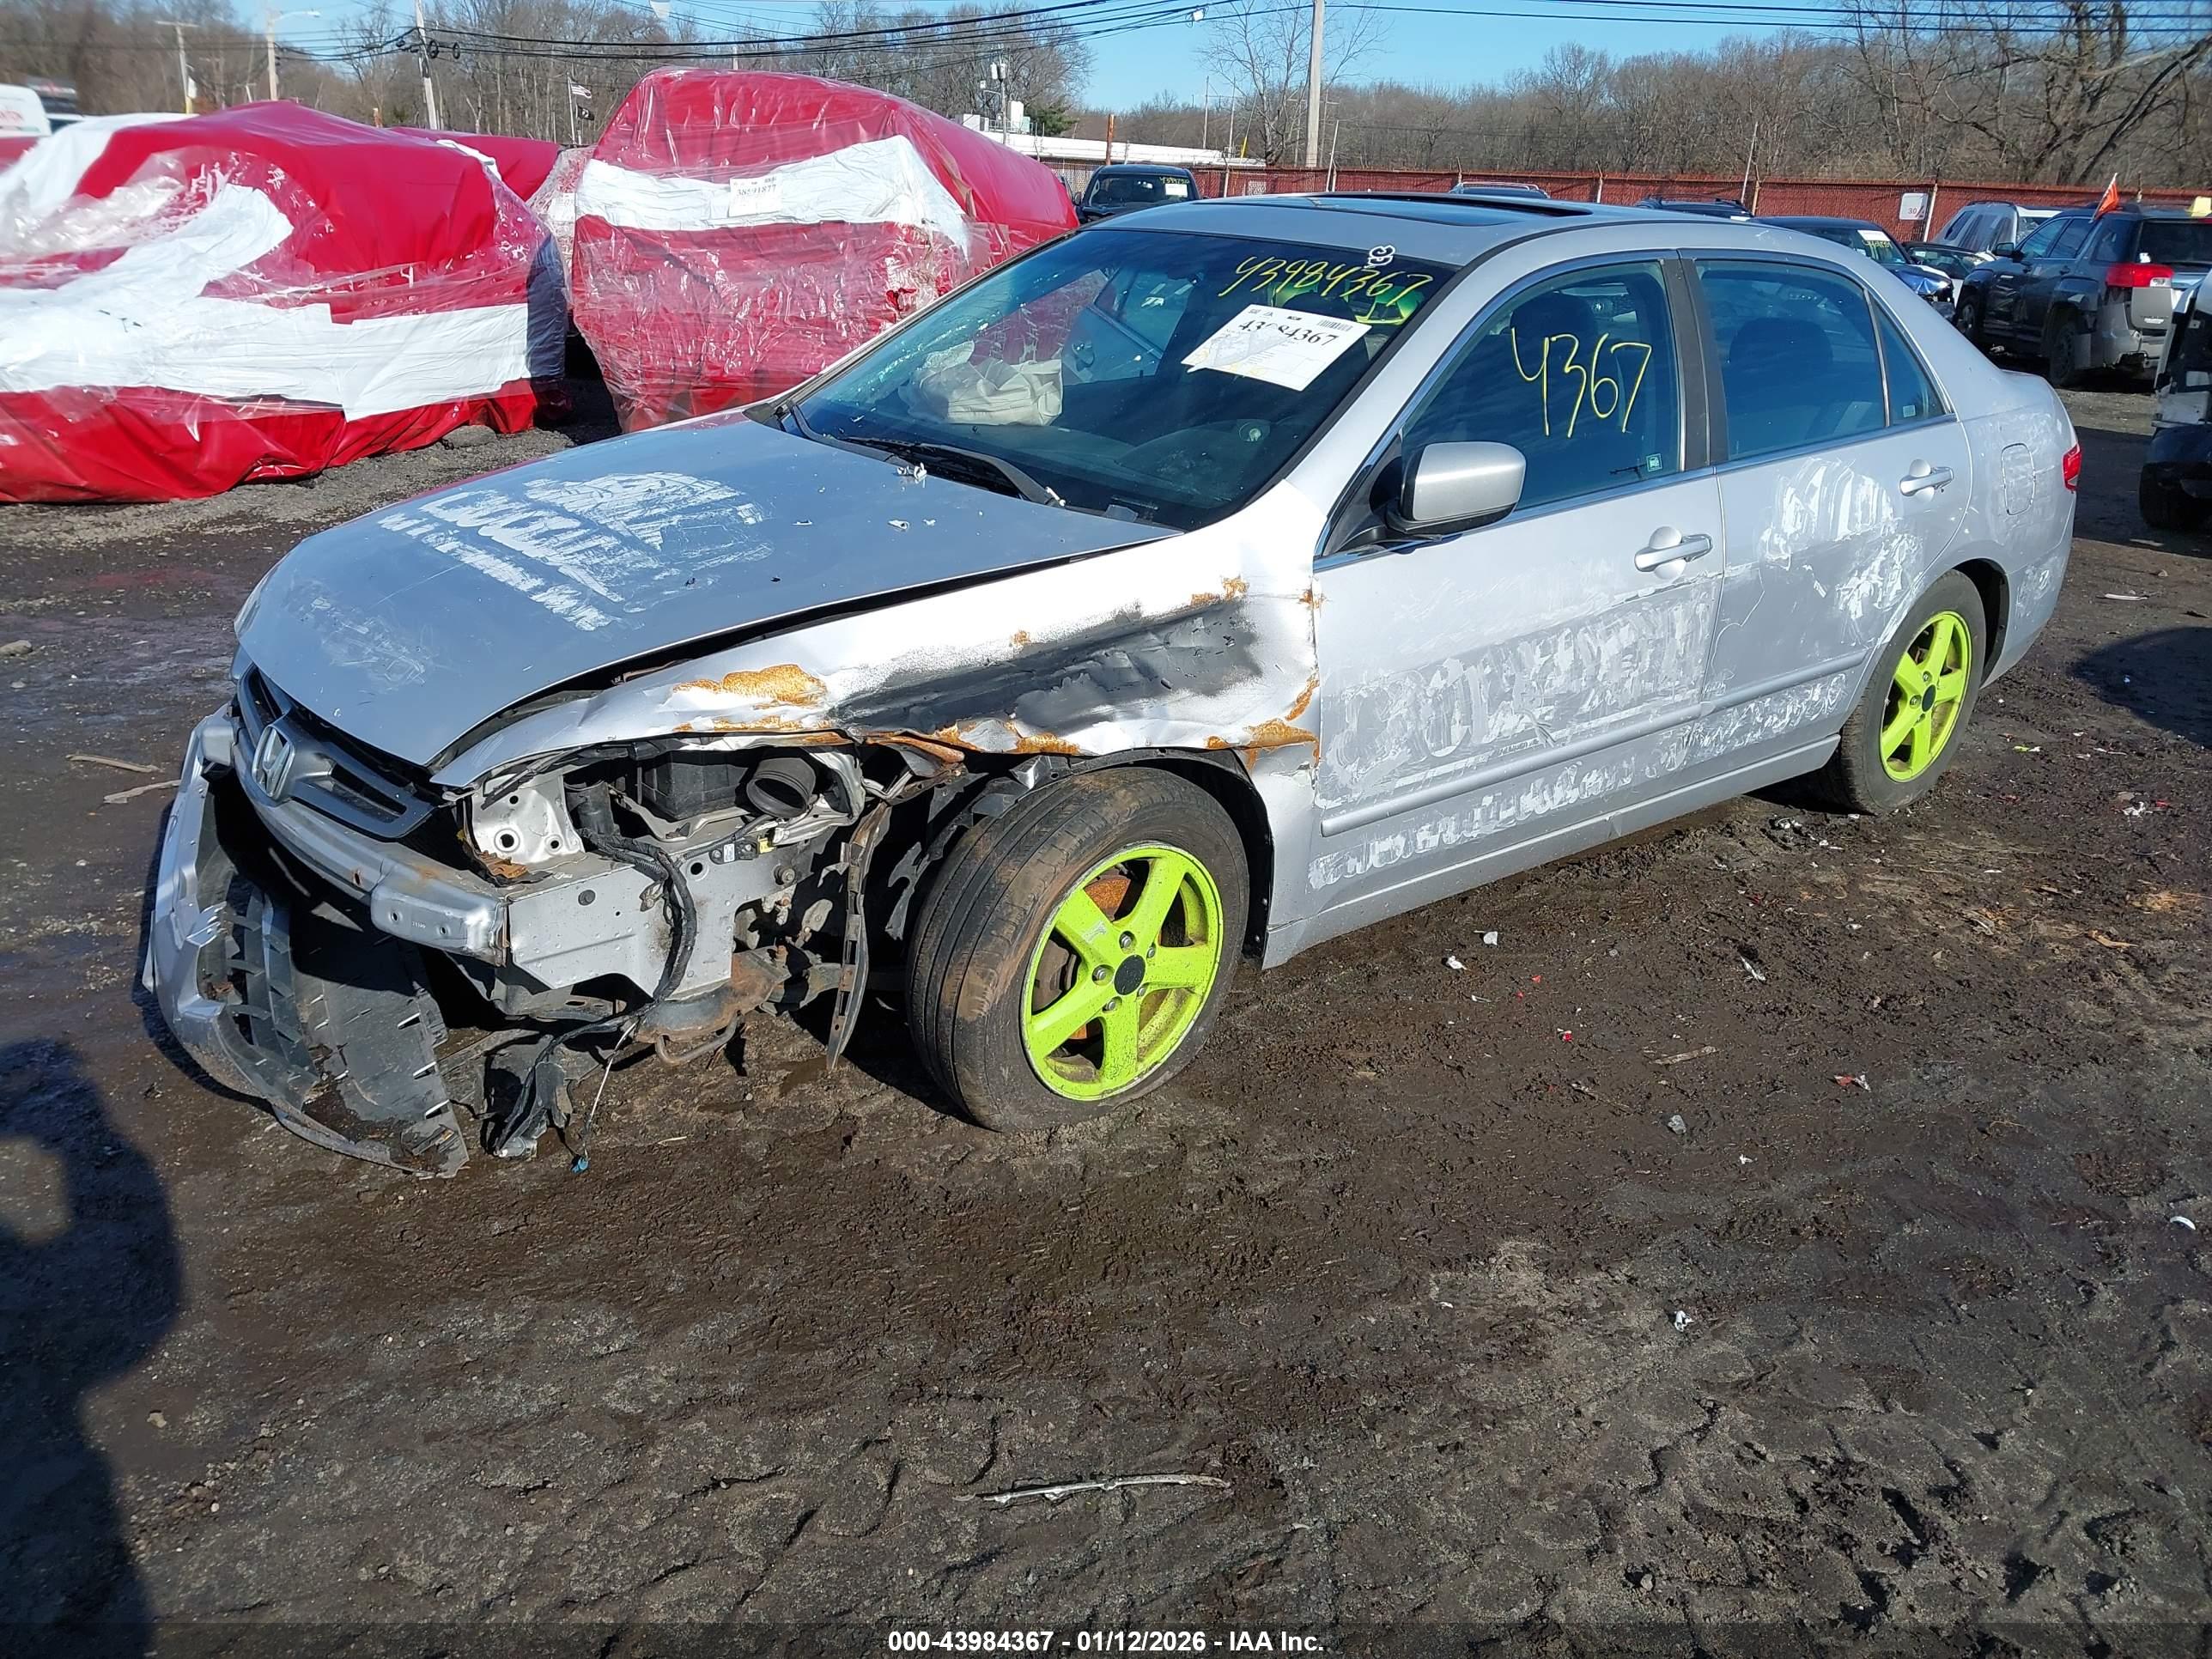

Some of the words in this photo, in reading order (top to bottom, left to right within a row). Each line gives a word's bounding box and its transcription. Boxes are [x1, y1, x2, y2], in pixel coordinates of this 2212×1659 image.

[1218, 257, 1434, 307] 43984367
[1238, 319, 1340, 347] 4384367
[1511, 327, 1652, 438] 4367
